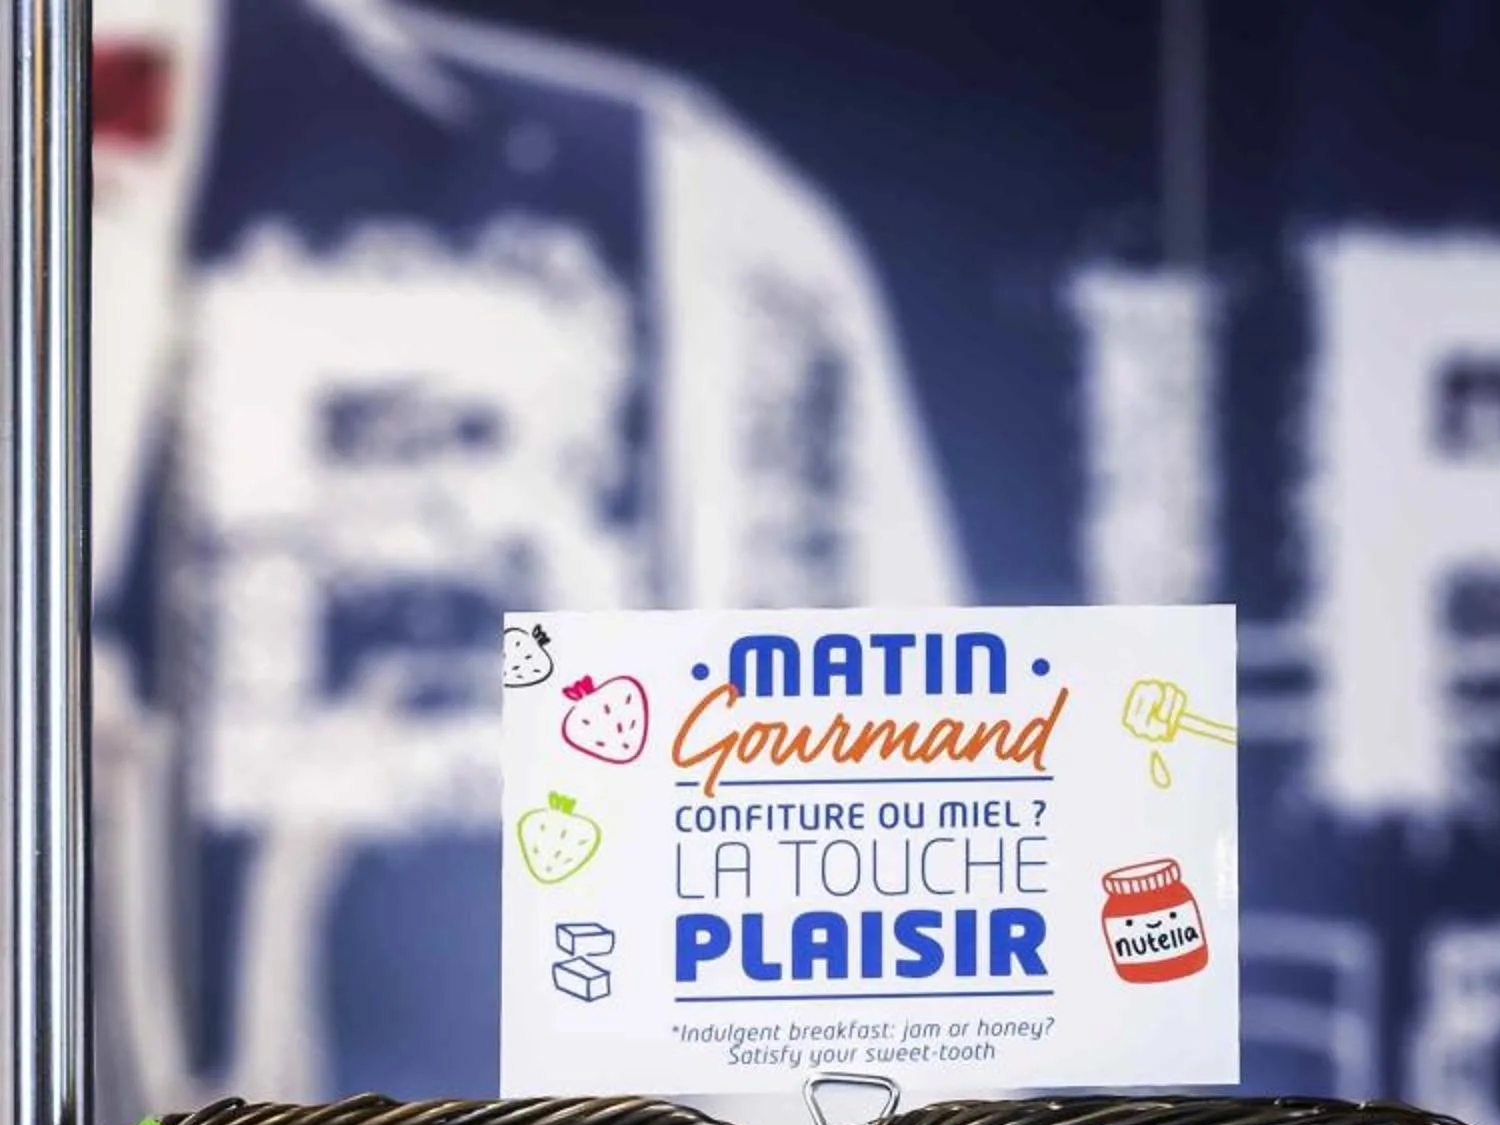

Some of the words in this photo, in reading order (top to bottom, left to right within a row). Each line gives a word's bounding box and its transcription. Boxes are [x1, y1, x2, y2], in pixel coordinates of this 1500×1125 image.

[729, 632, 1006, 697] MATIN
[672, 682, 1069, 797] Gourmand
[675, 803, 865, 832] CONFITURE
[879, 801, 924, 829] OU
[939, 800, 1020, 827] MIEL
[1033, 800, 1047, 826] ?
[676, 841, 751, 899] LA
[778, 836, 1049, 897] TOUCHE
[675, 907, 1049, 982] PLAISIR
[1115, 926, 1199, 957] nutella
[789, 1020, 896, 1042] breakfast:
[901, 1021, 941, 1042] jam
[948, 1022, 971, 1038] or
[977, 1017, 1054, 1041] honey?
[728, 1043, 801, 1068] Satisfy
[810, 1048, 857, 1067] your
[865, 1042, 996, 1063] sweet-tooth
